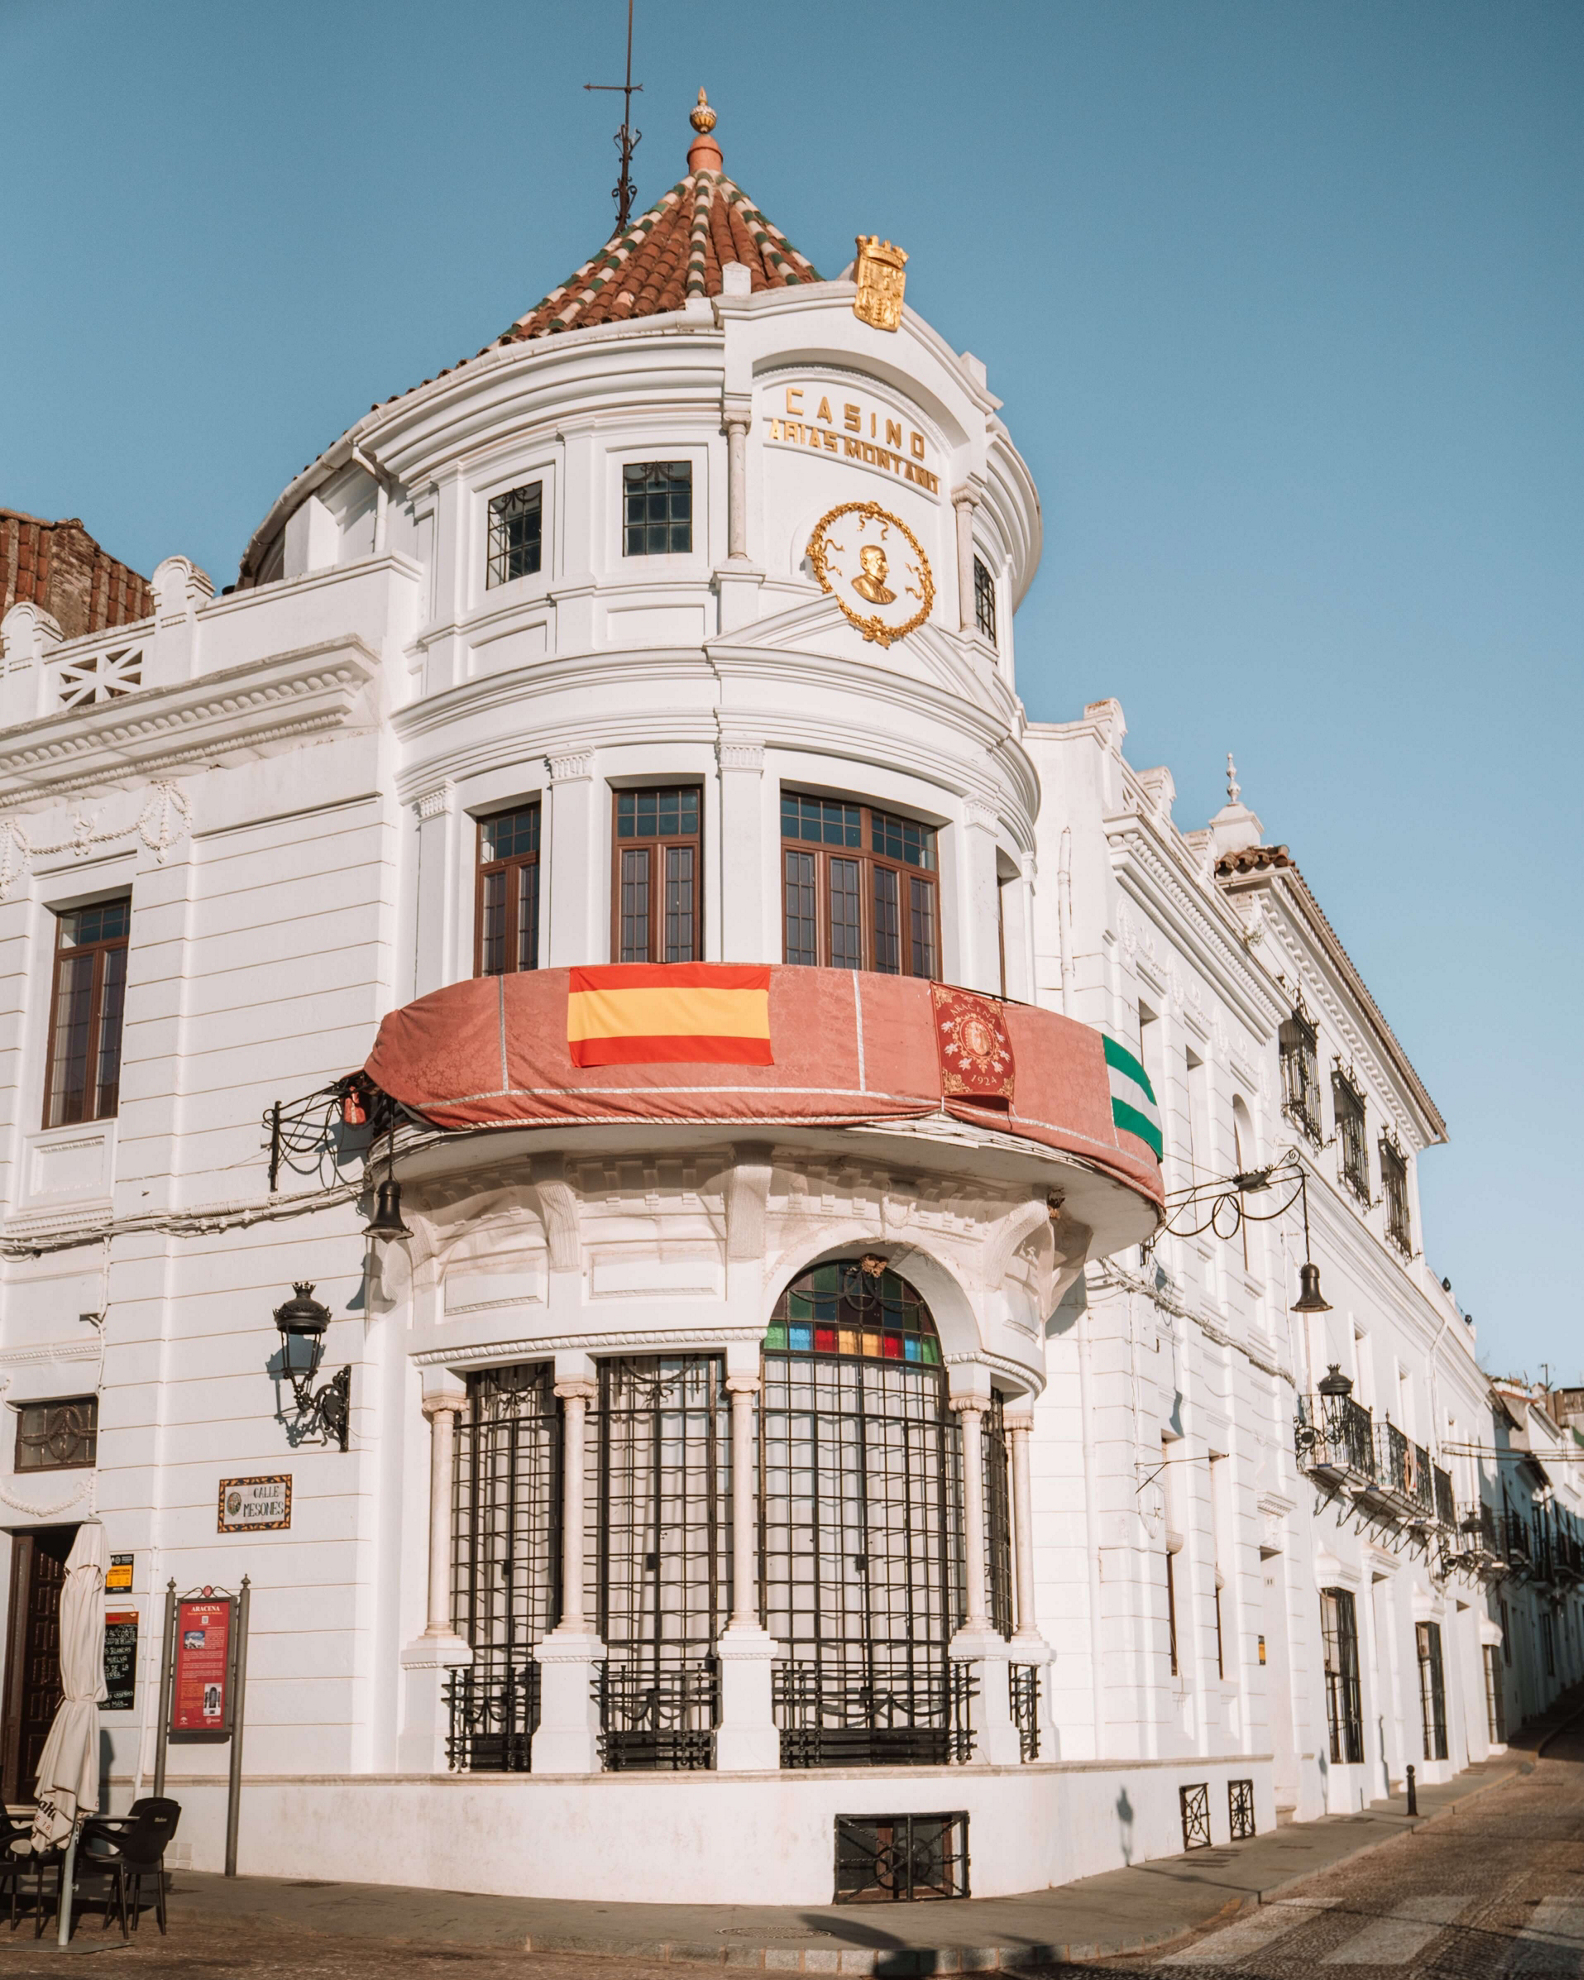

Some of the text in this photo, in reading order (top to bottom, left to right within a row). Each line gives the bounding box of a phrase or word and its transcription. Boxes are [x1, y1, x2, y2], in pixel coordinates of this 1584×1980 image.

[786, 387, 925, 462] CASINO
[769, 418, 838, 453] ARIAS
[950, 1003, 996, 1025] ARACENA
[971, 1074, 998, 1086] 1924
[253, 1485, 280, 1499] CALLE
[243, 1501, 284, 1518] MESONES
